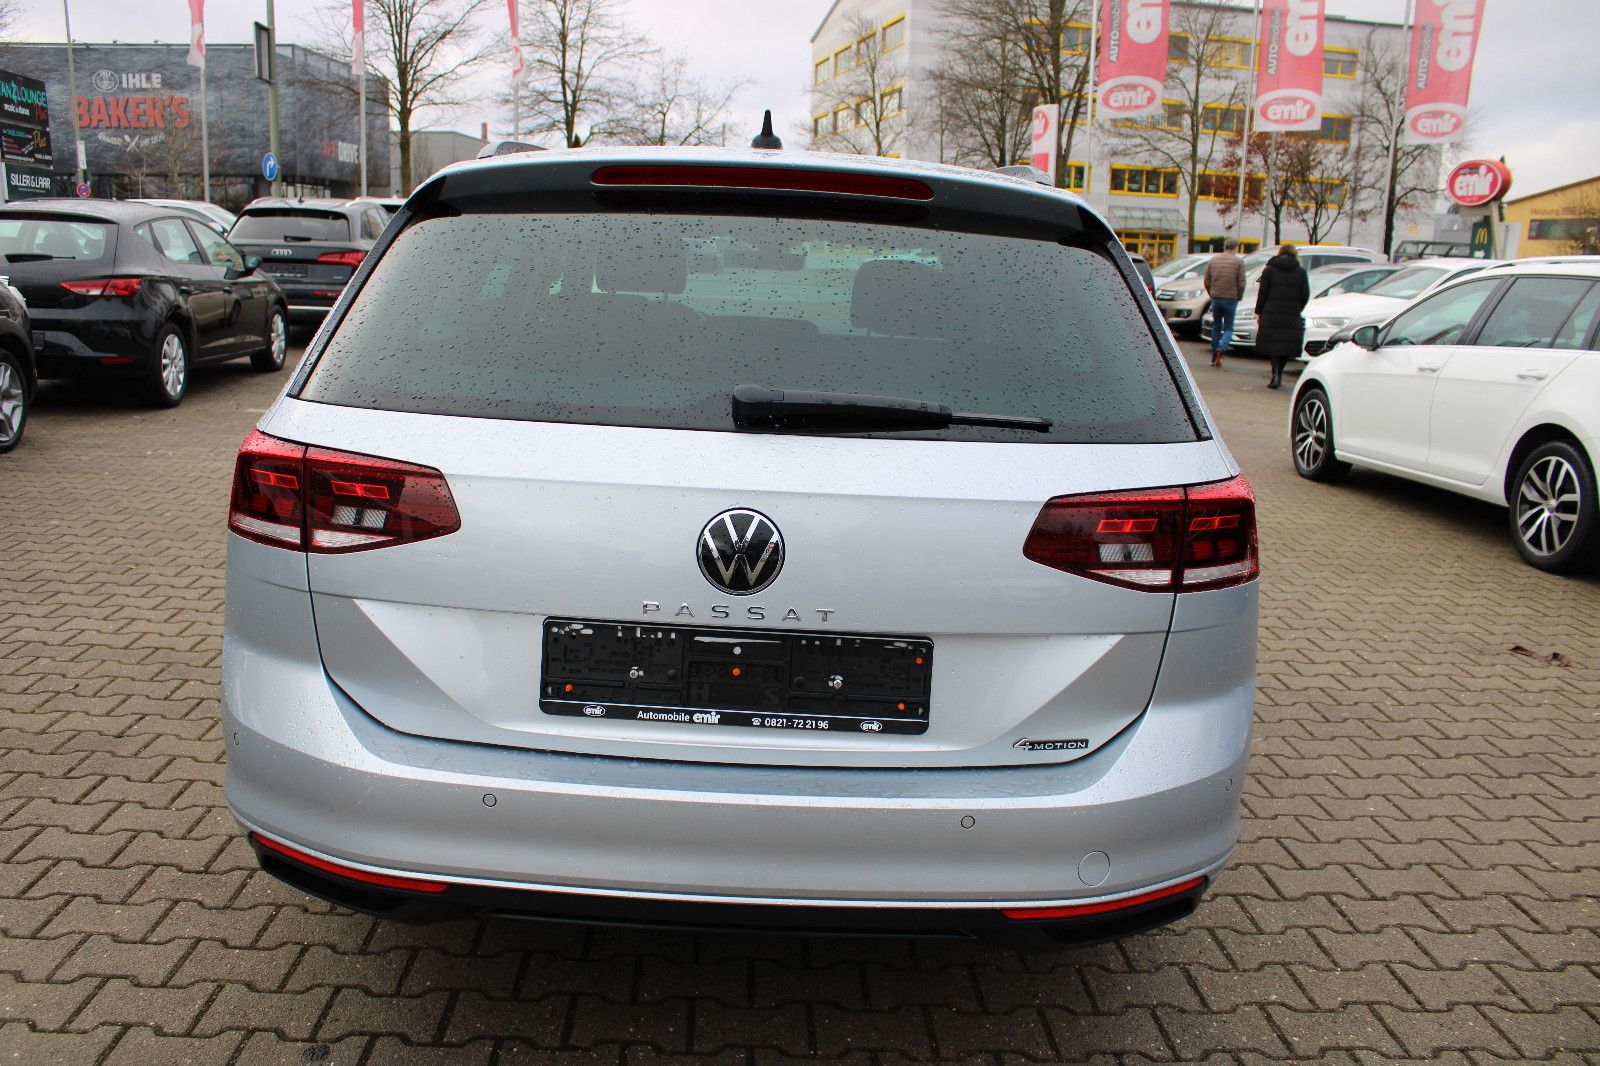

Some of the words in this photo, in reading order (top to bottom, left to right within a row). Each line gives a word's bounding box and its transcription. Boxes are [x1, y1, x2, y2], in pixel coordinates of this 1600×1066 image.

[121, 73, 162, 89] IHLE
[1108, 85, 1152, 108] emir
[71, 95, 190, 129] BAKER'S
[1266, 99, 1310, 121] emir
[1416, 113, 1457, 133] emir
[1455, 165, 1494, 196] emir
[642, 600, 835, 622] PASSAT
[584, 705, 605, 717] emir
[637, 709, 690, 722] Automobile
[692, 711, 721, 724] emir
[861, 721, 882, 732] emir
[1012, 738, 1087, 752] 4MOTION
